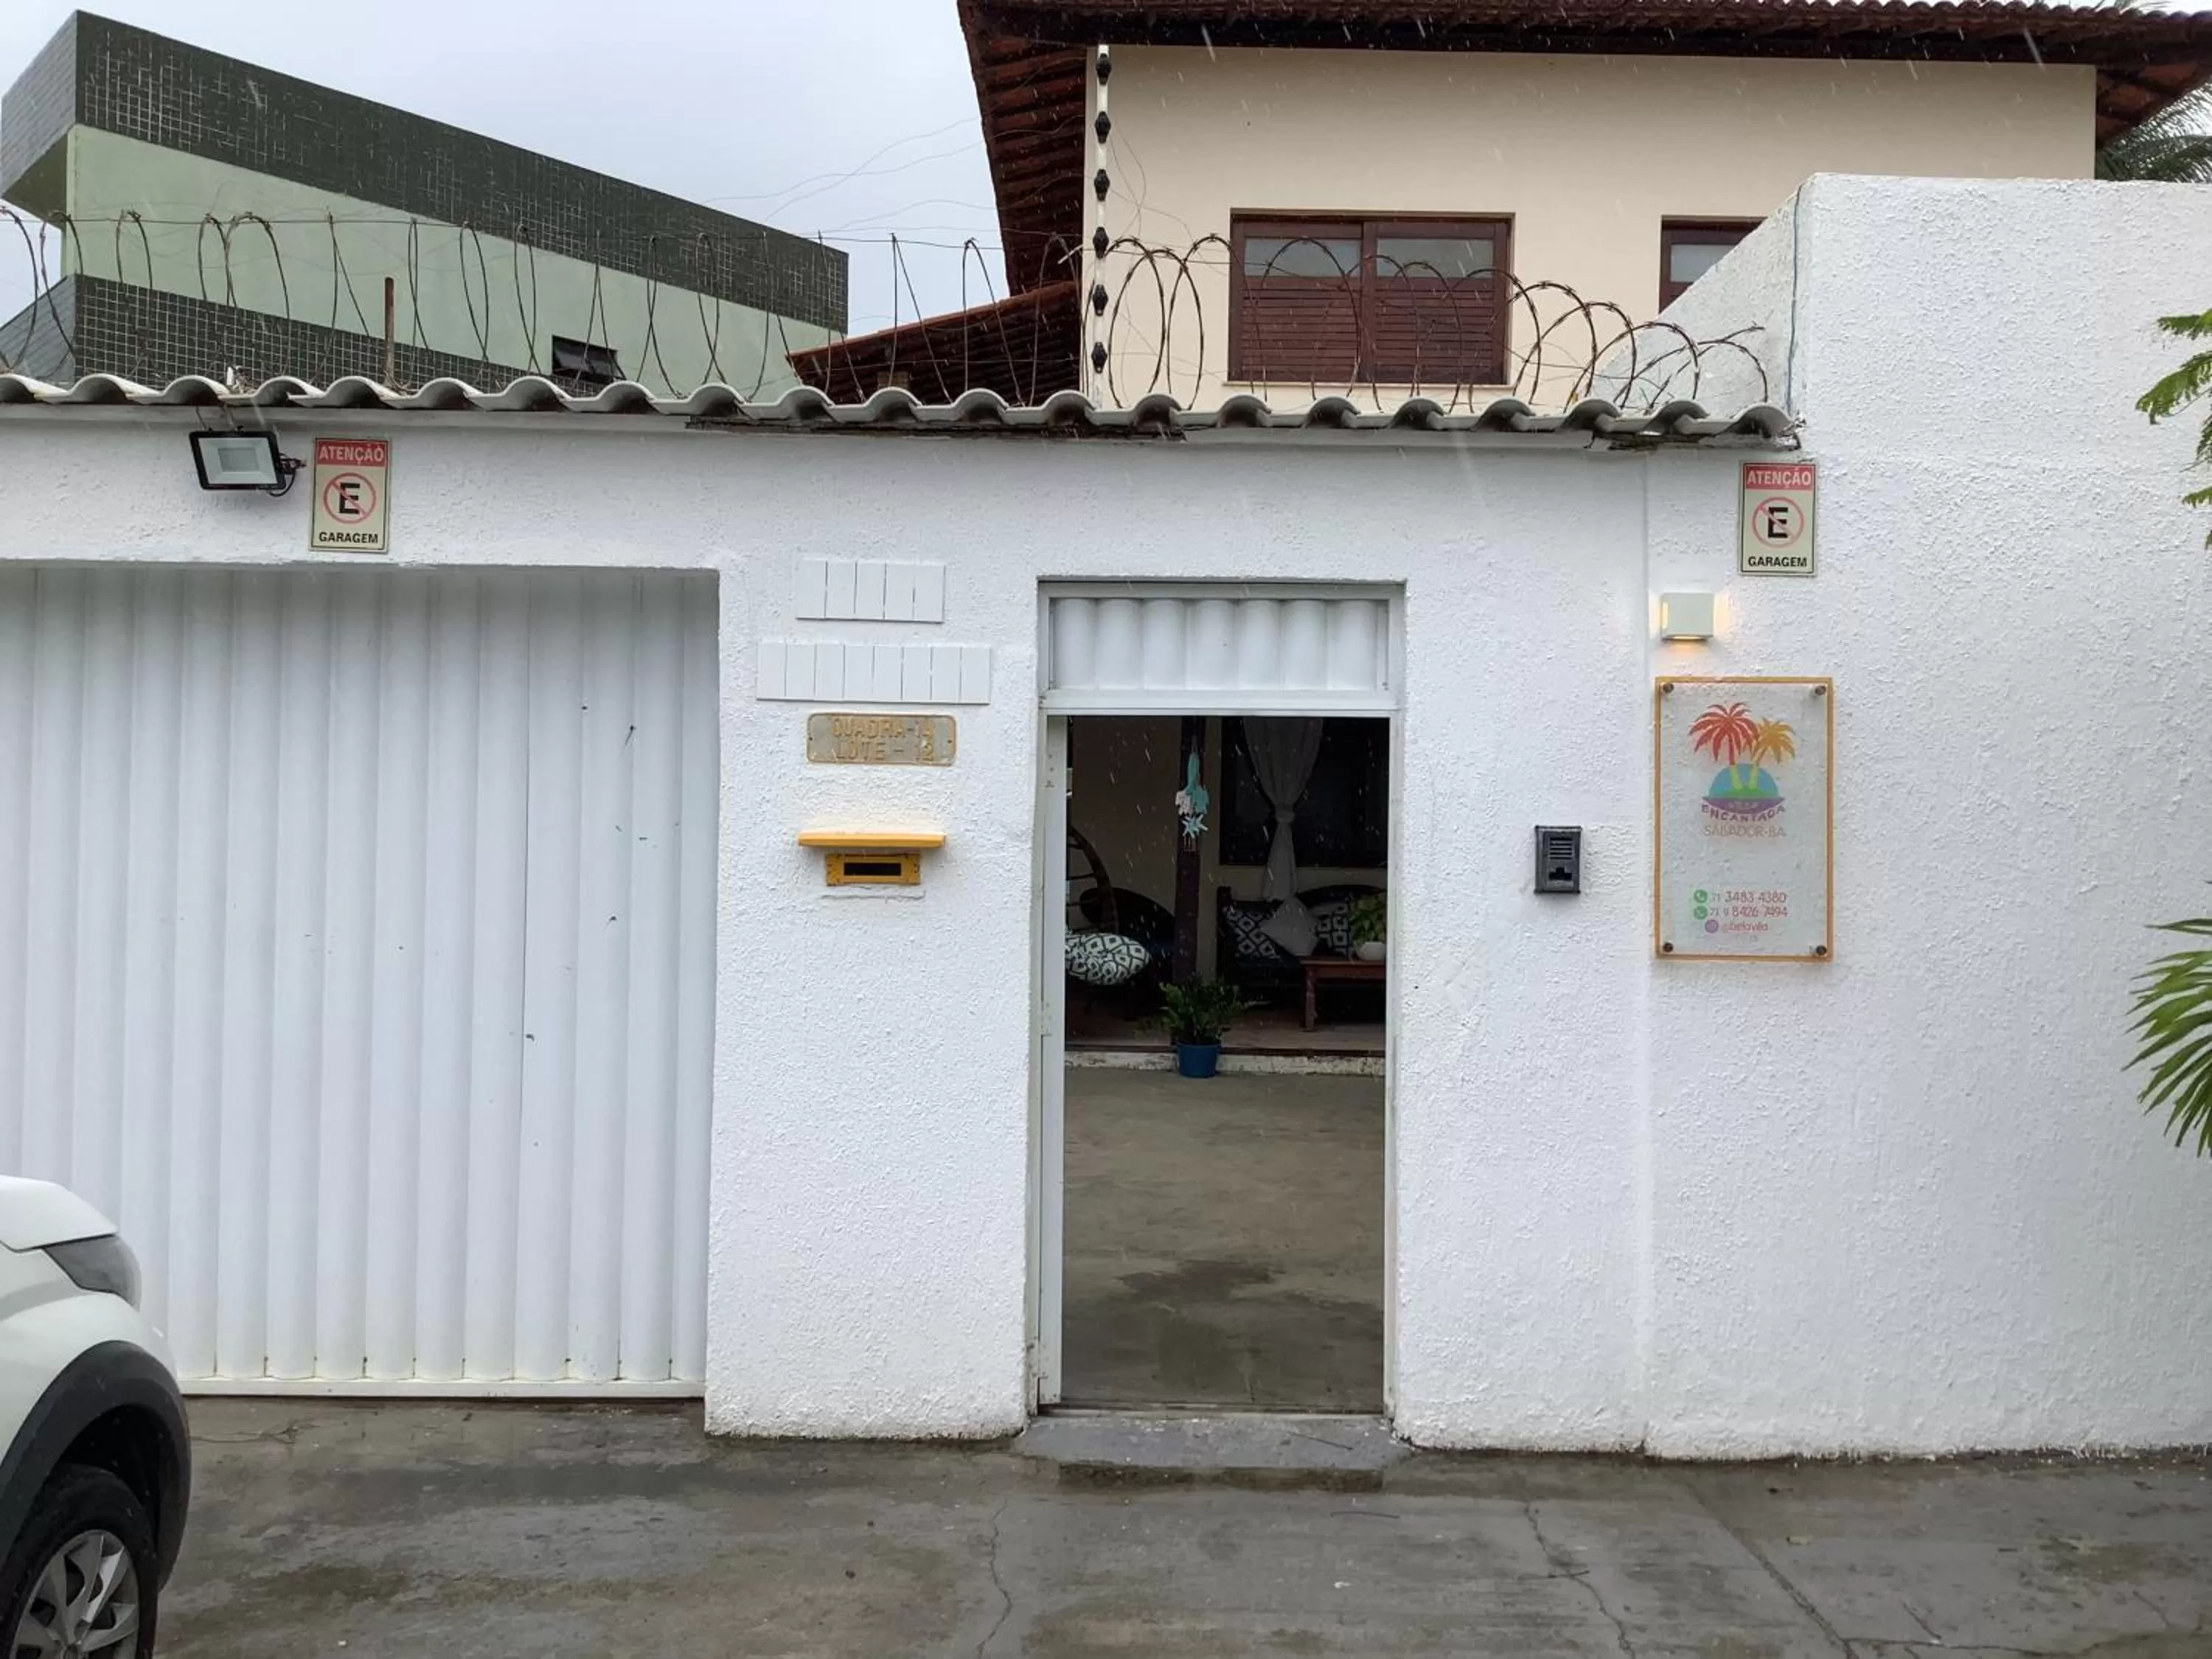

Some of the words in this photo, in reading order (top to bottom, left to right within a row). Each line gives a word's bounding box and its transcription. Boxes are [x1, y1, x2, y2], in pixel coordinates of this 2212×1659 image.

[319, 443, 384, 465] ATENÇÃO
[1747, 467, 1812, 488] ATENÇÃO
[339, 482, 361, 514] E
[1768, 507, 1789, 538] E
[319, 532, 378, 543] GARAGEM
[1748, 556, 1807, 567] GARAGEM
[1702, 804, 1786, 822] ENCANTADA
